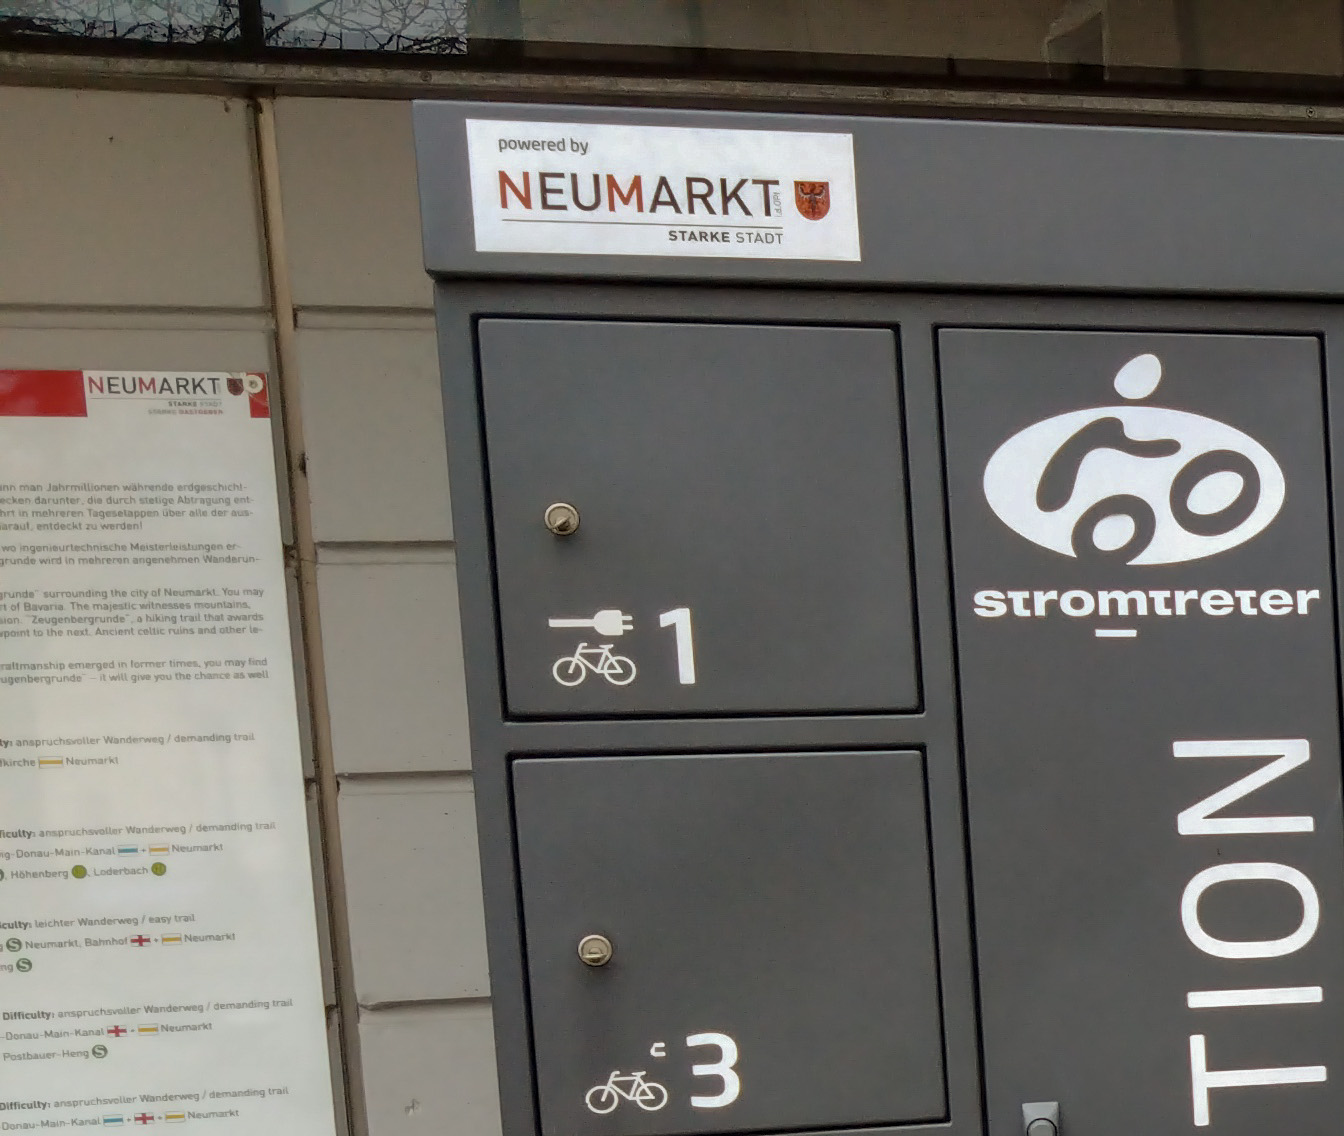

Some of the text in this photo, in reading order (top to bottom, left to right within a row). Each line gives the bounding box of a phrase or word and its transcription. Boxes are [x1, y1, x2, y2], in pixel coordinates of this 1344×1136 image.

[498, 137, 589, 156] powered by
[498, 170, 780, 217] NEUMARKT
[668, 230, 784, 245] STARKE STADT
[88, 376, 220, 395] NEUMARKT
[46, 482, 120, 492] Jahrmillionen
[87, 495, 103, 505] die
[105, 495, 136, 505] durch
[31, 508, 228, 519] mehreren Tagesetappen der
[36, 521, 83, 531] entdeckt
[20, 542, 224, 555] ingenieurtechnische Meisterleistungen
[39, 555, 62, 565] wird
[77, 555, 130, 565] mehreren
[132, 555, 200, 567] angenehmen
[43, 589, 108, 600] surrounding
[110, 588, 128, 598] the
[130, 588, 149, 599] city
[151, 587, 162, 598] of
[221, 587, 240, 597] You
[242, 588, 264, 598] may
[70, 601, 90, 611] The
[92, 601, 137, 613] majestic
[139, 600, 192, 610] witnesses
[972, 588, 1320, 618] stromtreter
[145, 611, 264, 624] hiking trail that awards
[33, 625, 247, 637] to the Ancient celtic ruins and other
[659, 607, 696, 685] 1
[68, 656, 268, 672] emerged in former you may find
[109, 669, 269, 684] will give you the chance as well
[16, 732, 255, 748] anspruchsvoller Wanderweg demanding trail
[65, 756, 119, 766] Neumarkt
[38, 821, 277, 838] anspruchsvoller Wanderweg demanding trail
[171, 842, 224, 854] Neumarkt
[10, 865, 149, 880] Höhenberg Loderbach
[34, 913, 196, 929] leichter Wanderweg easy trail
[84, 936, 128, 948] Bahnhof
[184, 932, 236, 944] Neumarkt
[2, 998, 293, 1021] Difficulty: anspruchsvoller Wanderweg demanding trail
[160, 1022, 213, 1033] Neumarkt
[3, 1049, 90, 1062] Postbauer-Heng
[685, 1032, 741, 1109] 3
[54, 1096, 137, 1109] anspruchsvoller
[139, 1092, 200, 1104] Wanderweg
[209, 1088, 266, 1099] demanding
[268, 1086, 289, 1096] trail
[1, 1109, 239, 1131] Donau-Main-Kanal Neumarkt
